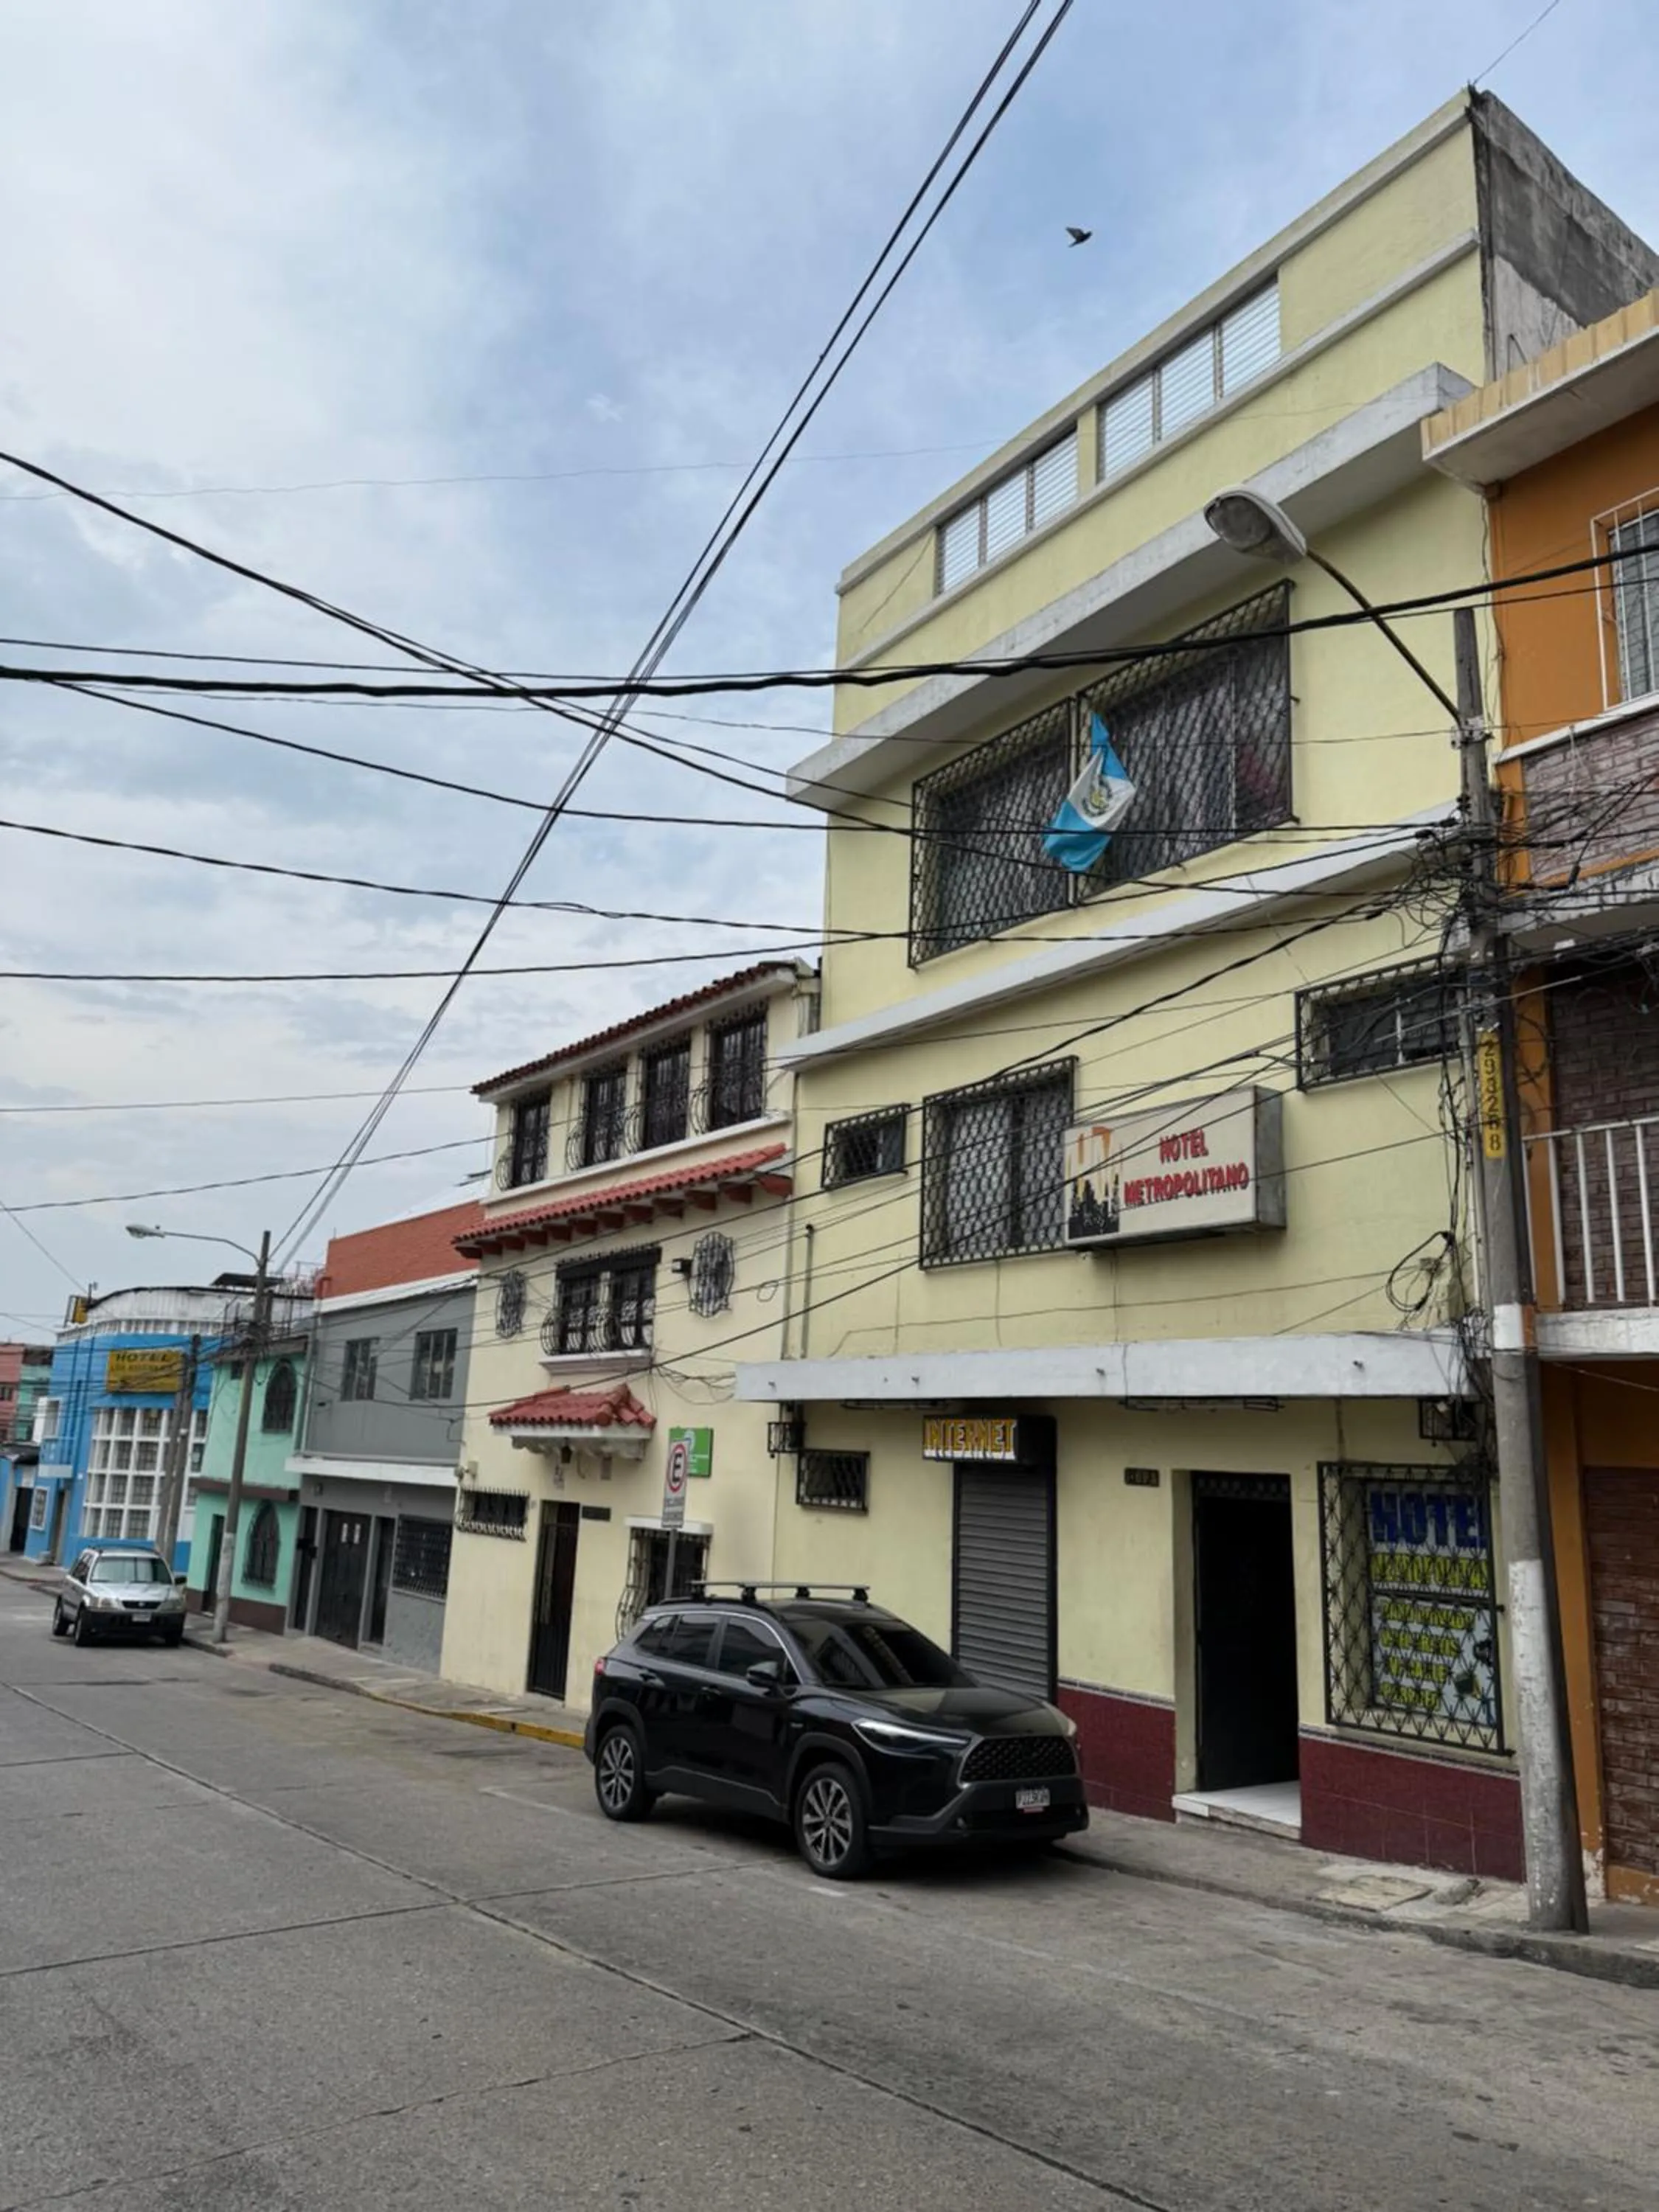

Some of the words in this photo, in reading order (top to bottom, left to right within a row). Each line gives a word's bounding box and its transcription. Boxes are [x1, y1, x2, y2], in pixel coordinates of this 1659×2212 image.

[1159, 1128, 1209, 1164] HOTEL
[1124, 1162, 1249, 1207] METROPOLITANO
[923, 1419, 1017, 1460] INTERNET
[672, 1453, 683, 1483] E
